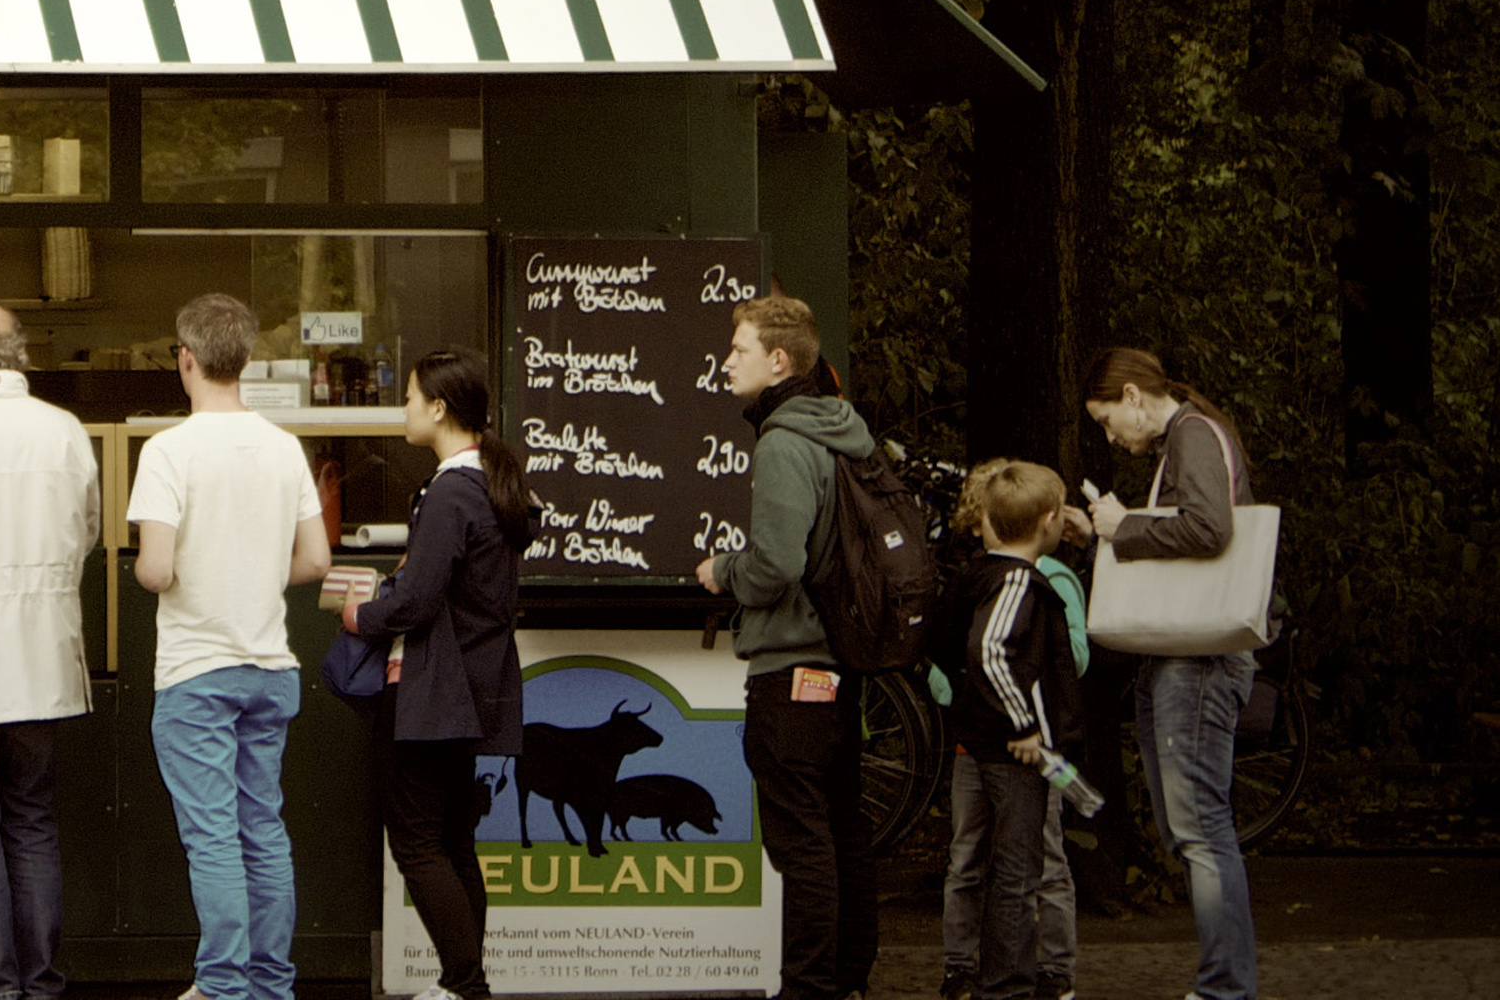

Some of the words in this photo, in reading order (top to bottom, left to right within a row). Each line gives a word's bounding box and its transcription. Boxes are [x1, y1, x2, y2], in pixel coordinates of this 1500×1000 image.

[526, 252, 657, 288] Currywurst
[528, 287, 563, 311] mit
[328, 324, 359, 338] Like
[524, 336, 639, 372] Bratwurst
[527, 368, 554, 388] im
[522, 418, 608, 453] Boulette
[525, 452, 564, 474] mit
[696, 434, 749, 479] 2,90
[693, 512, 747, 557] 2,20
[523, 536, 556, 560] mit
[478, 855, 744, 894] EULAND
[484, 926, 539, 939] nerkannt
[542, 929, 571, 939] vom
[403, 945, 422, 958] für
[507, 945, 533, 959] und
[537, 945, 655, 959] umweltschonende
[659, 945, 762, 961] Nutztierhaltung
[540, 965, 579, 978] 53115
[584, 965, 618, 978] Bonn
